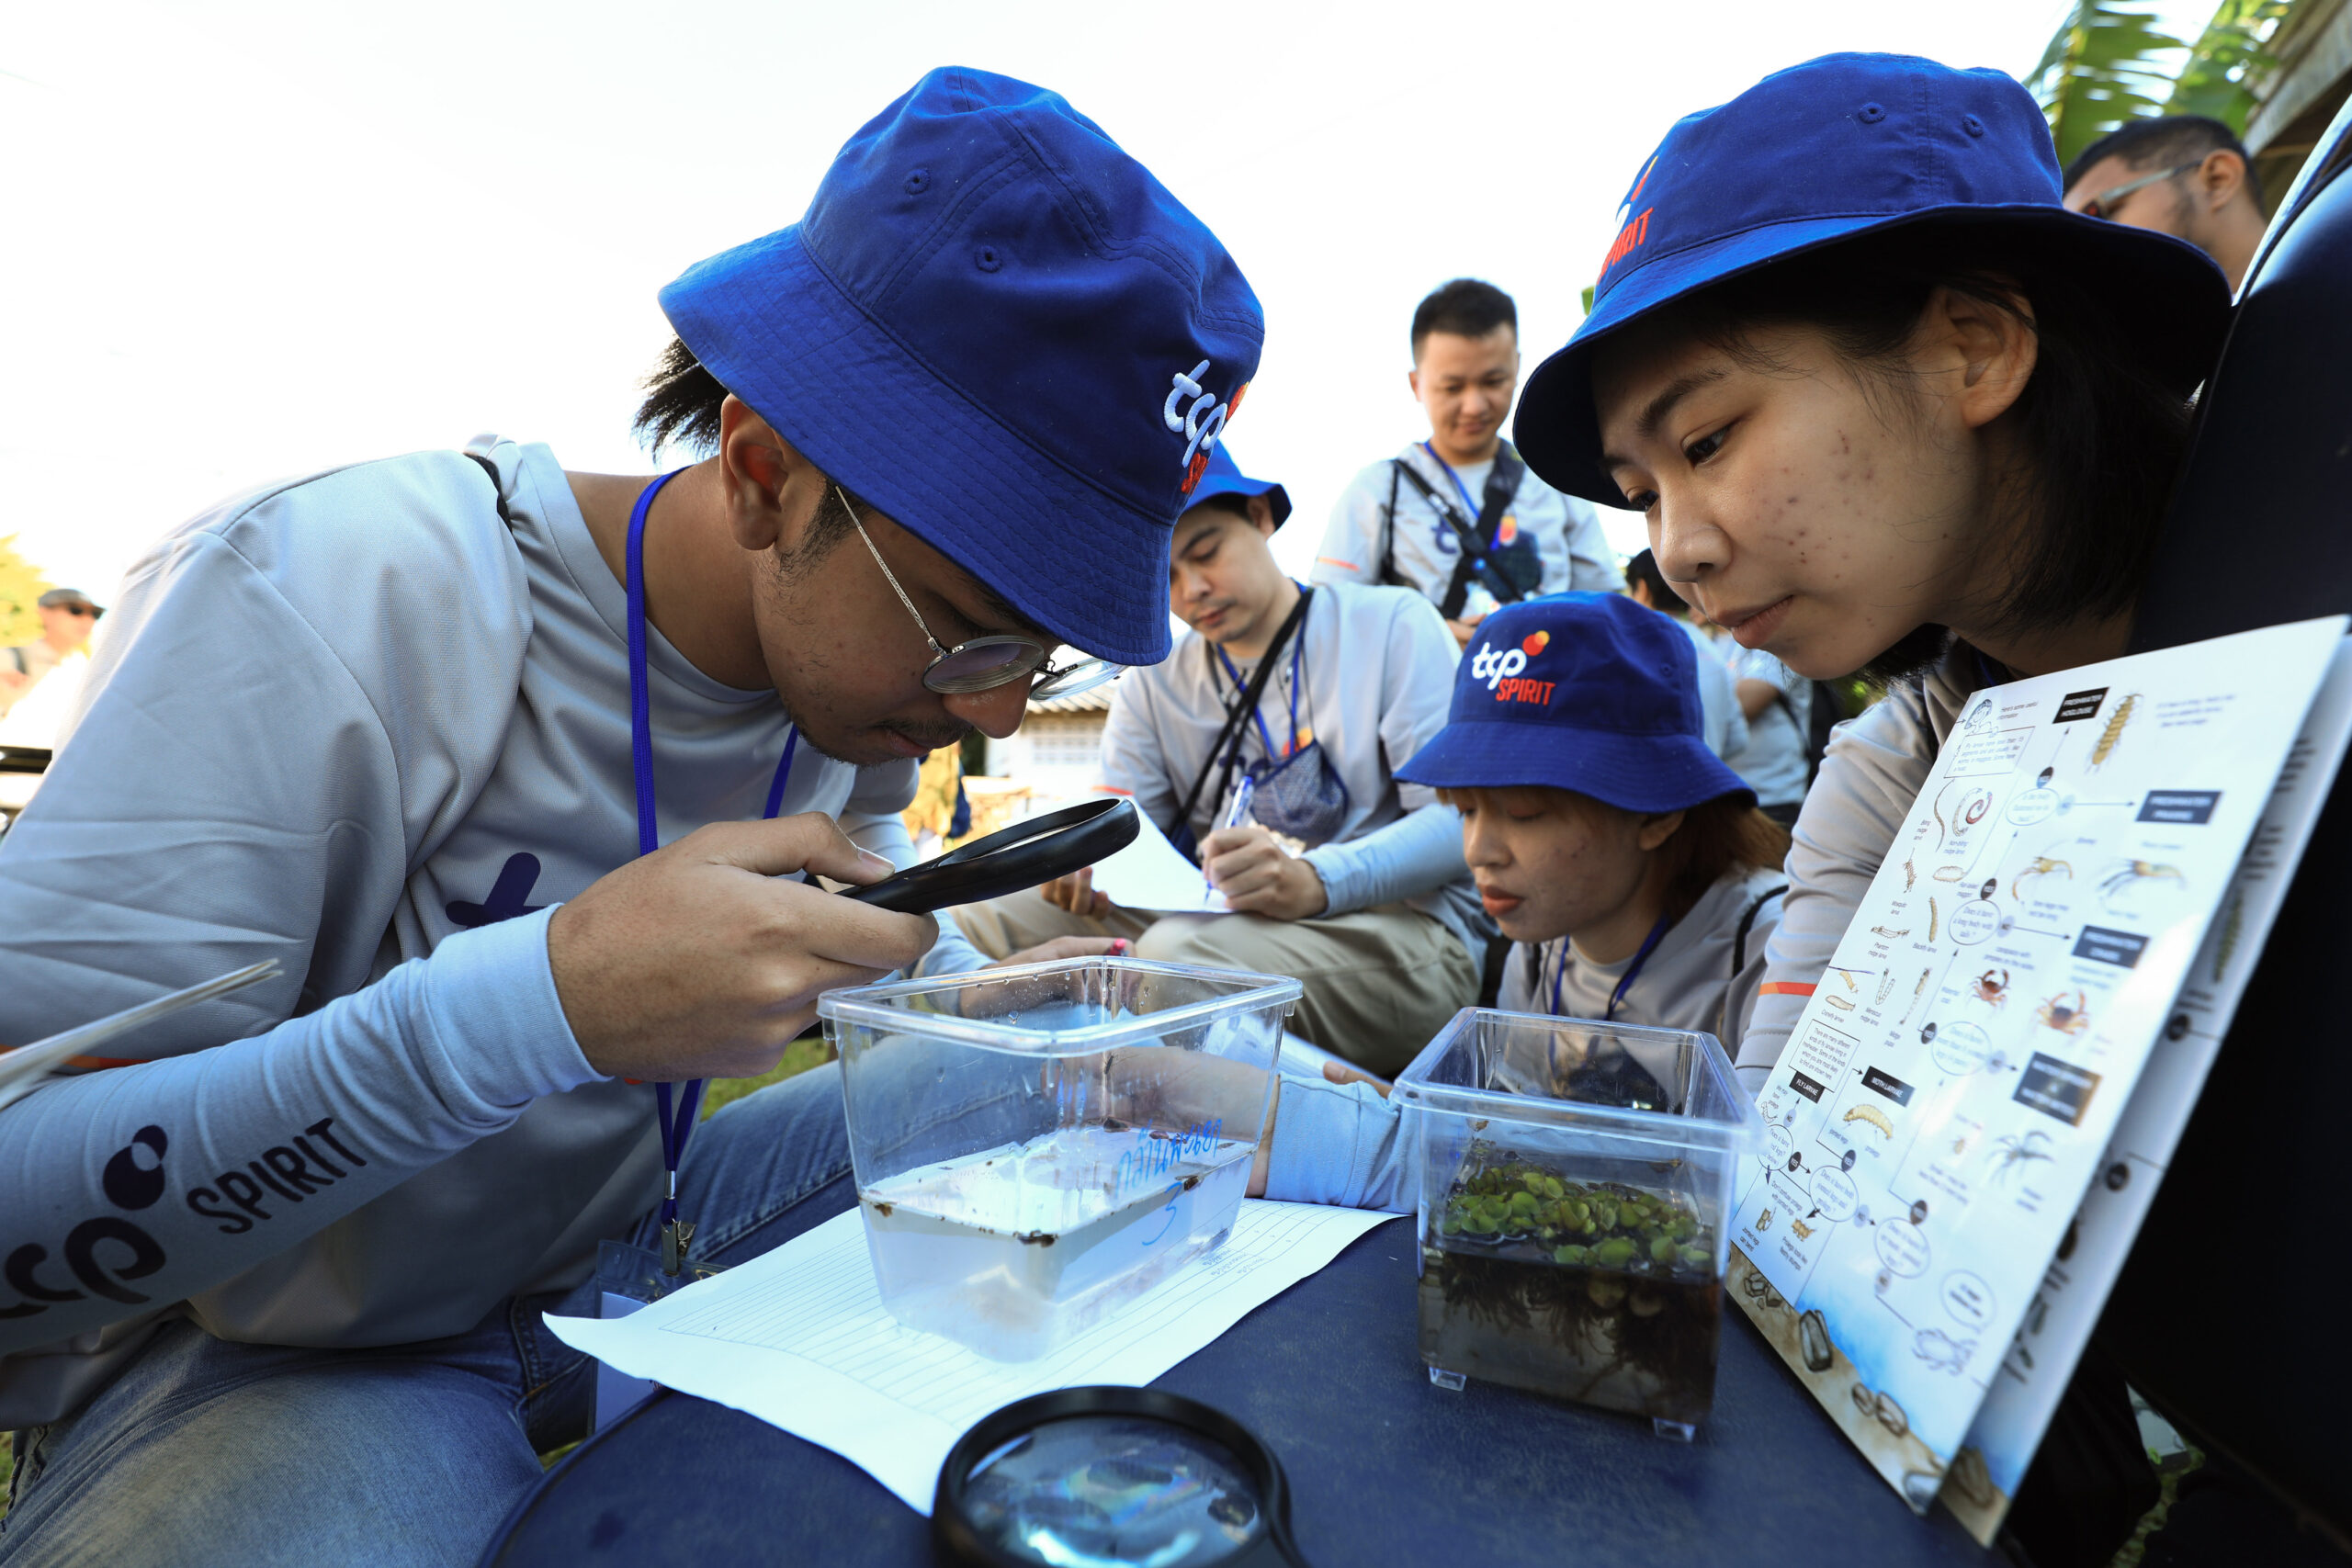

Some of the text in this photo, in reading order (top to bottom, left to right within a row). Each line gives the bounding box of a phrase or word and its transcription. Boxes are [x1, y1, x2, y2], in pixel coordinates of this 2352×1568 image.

[1164, 359, 1227, 468] tcp
[1472, 642, 1527, 690] tcp
[1496, 678, 1555, 705] SPIRIT
[1795, 1078, 1819, 1097] FLY LARVAE
[1883, 1084, 1905, 1099] LARVAE
[187, 1118, 367, 1234] SPIRIT
[0, 1216, 166, 1319] cp
